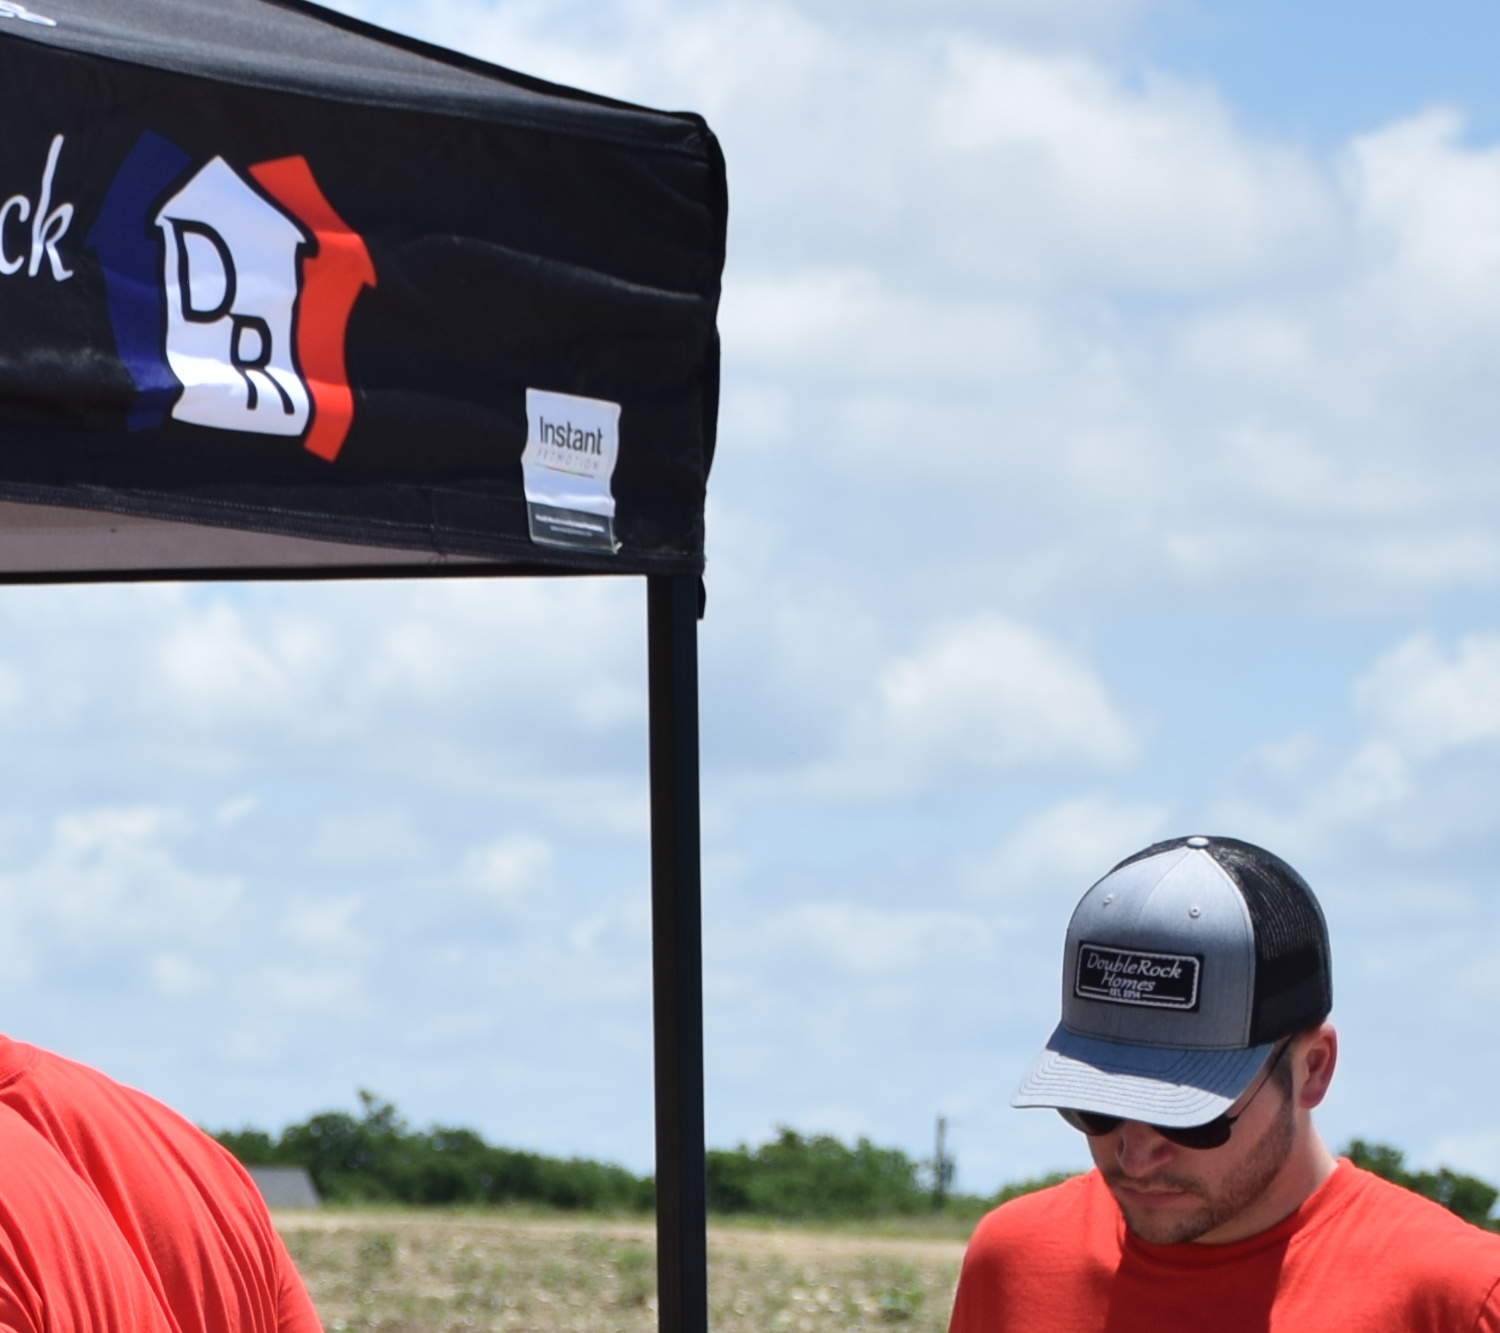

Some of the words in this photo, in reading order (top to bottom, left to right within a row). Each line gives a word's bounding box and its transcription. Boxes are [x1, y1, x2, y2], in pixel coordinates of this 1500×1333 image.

[539, 416, 603, 456] Instant
[1086, 953, 1182, 979] DoubleRock
[1100, 971, 1156, 992] Homes
